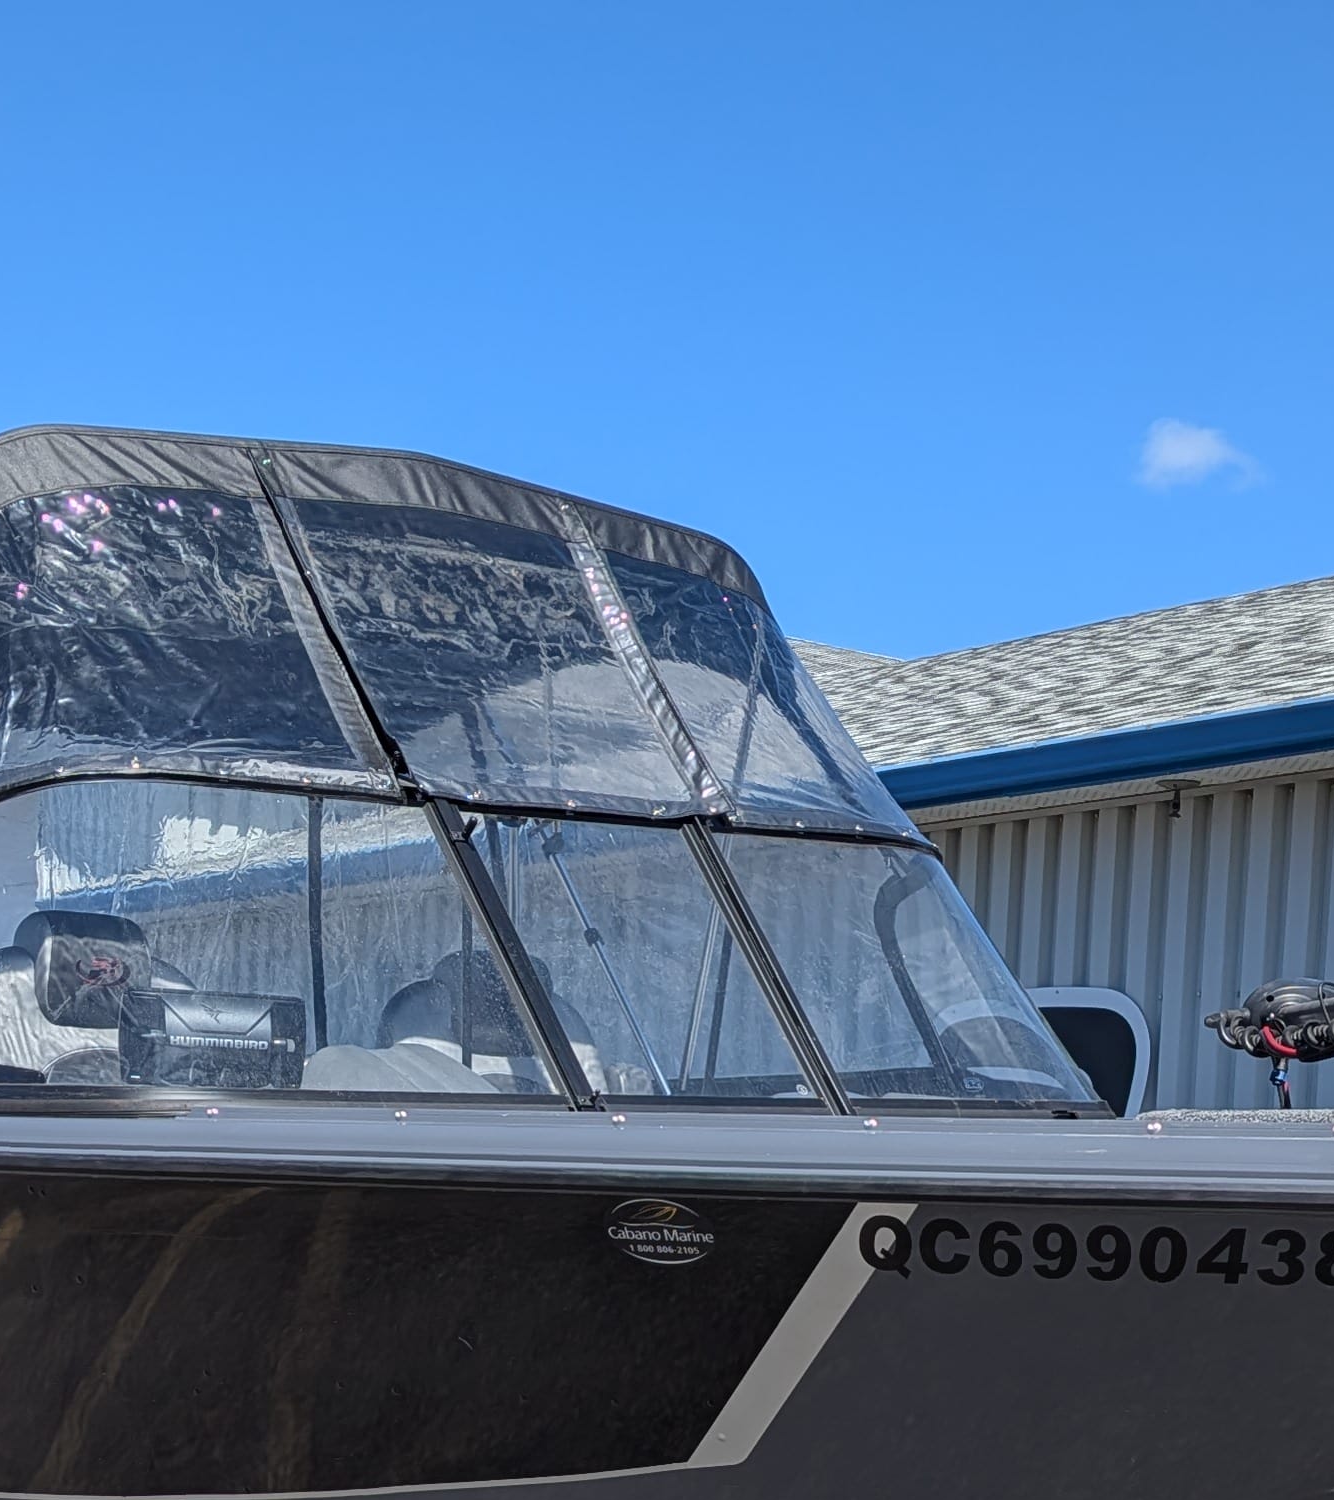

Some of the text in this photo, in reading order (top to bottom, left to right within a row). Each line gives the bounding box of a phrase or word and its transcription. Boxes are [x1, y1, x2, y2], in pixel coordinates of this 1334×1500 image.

[169, 1035, 269, 1050] HUMMINBIRD
[608, 1226, 715, 1244] Cabano Marine
[637, 1245, 654, 1253] 800
